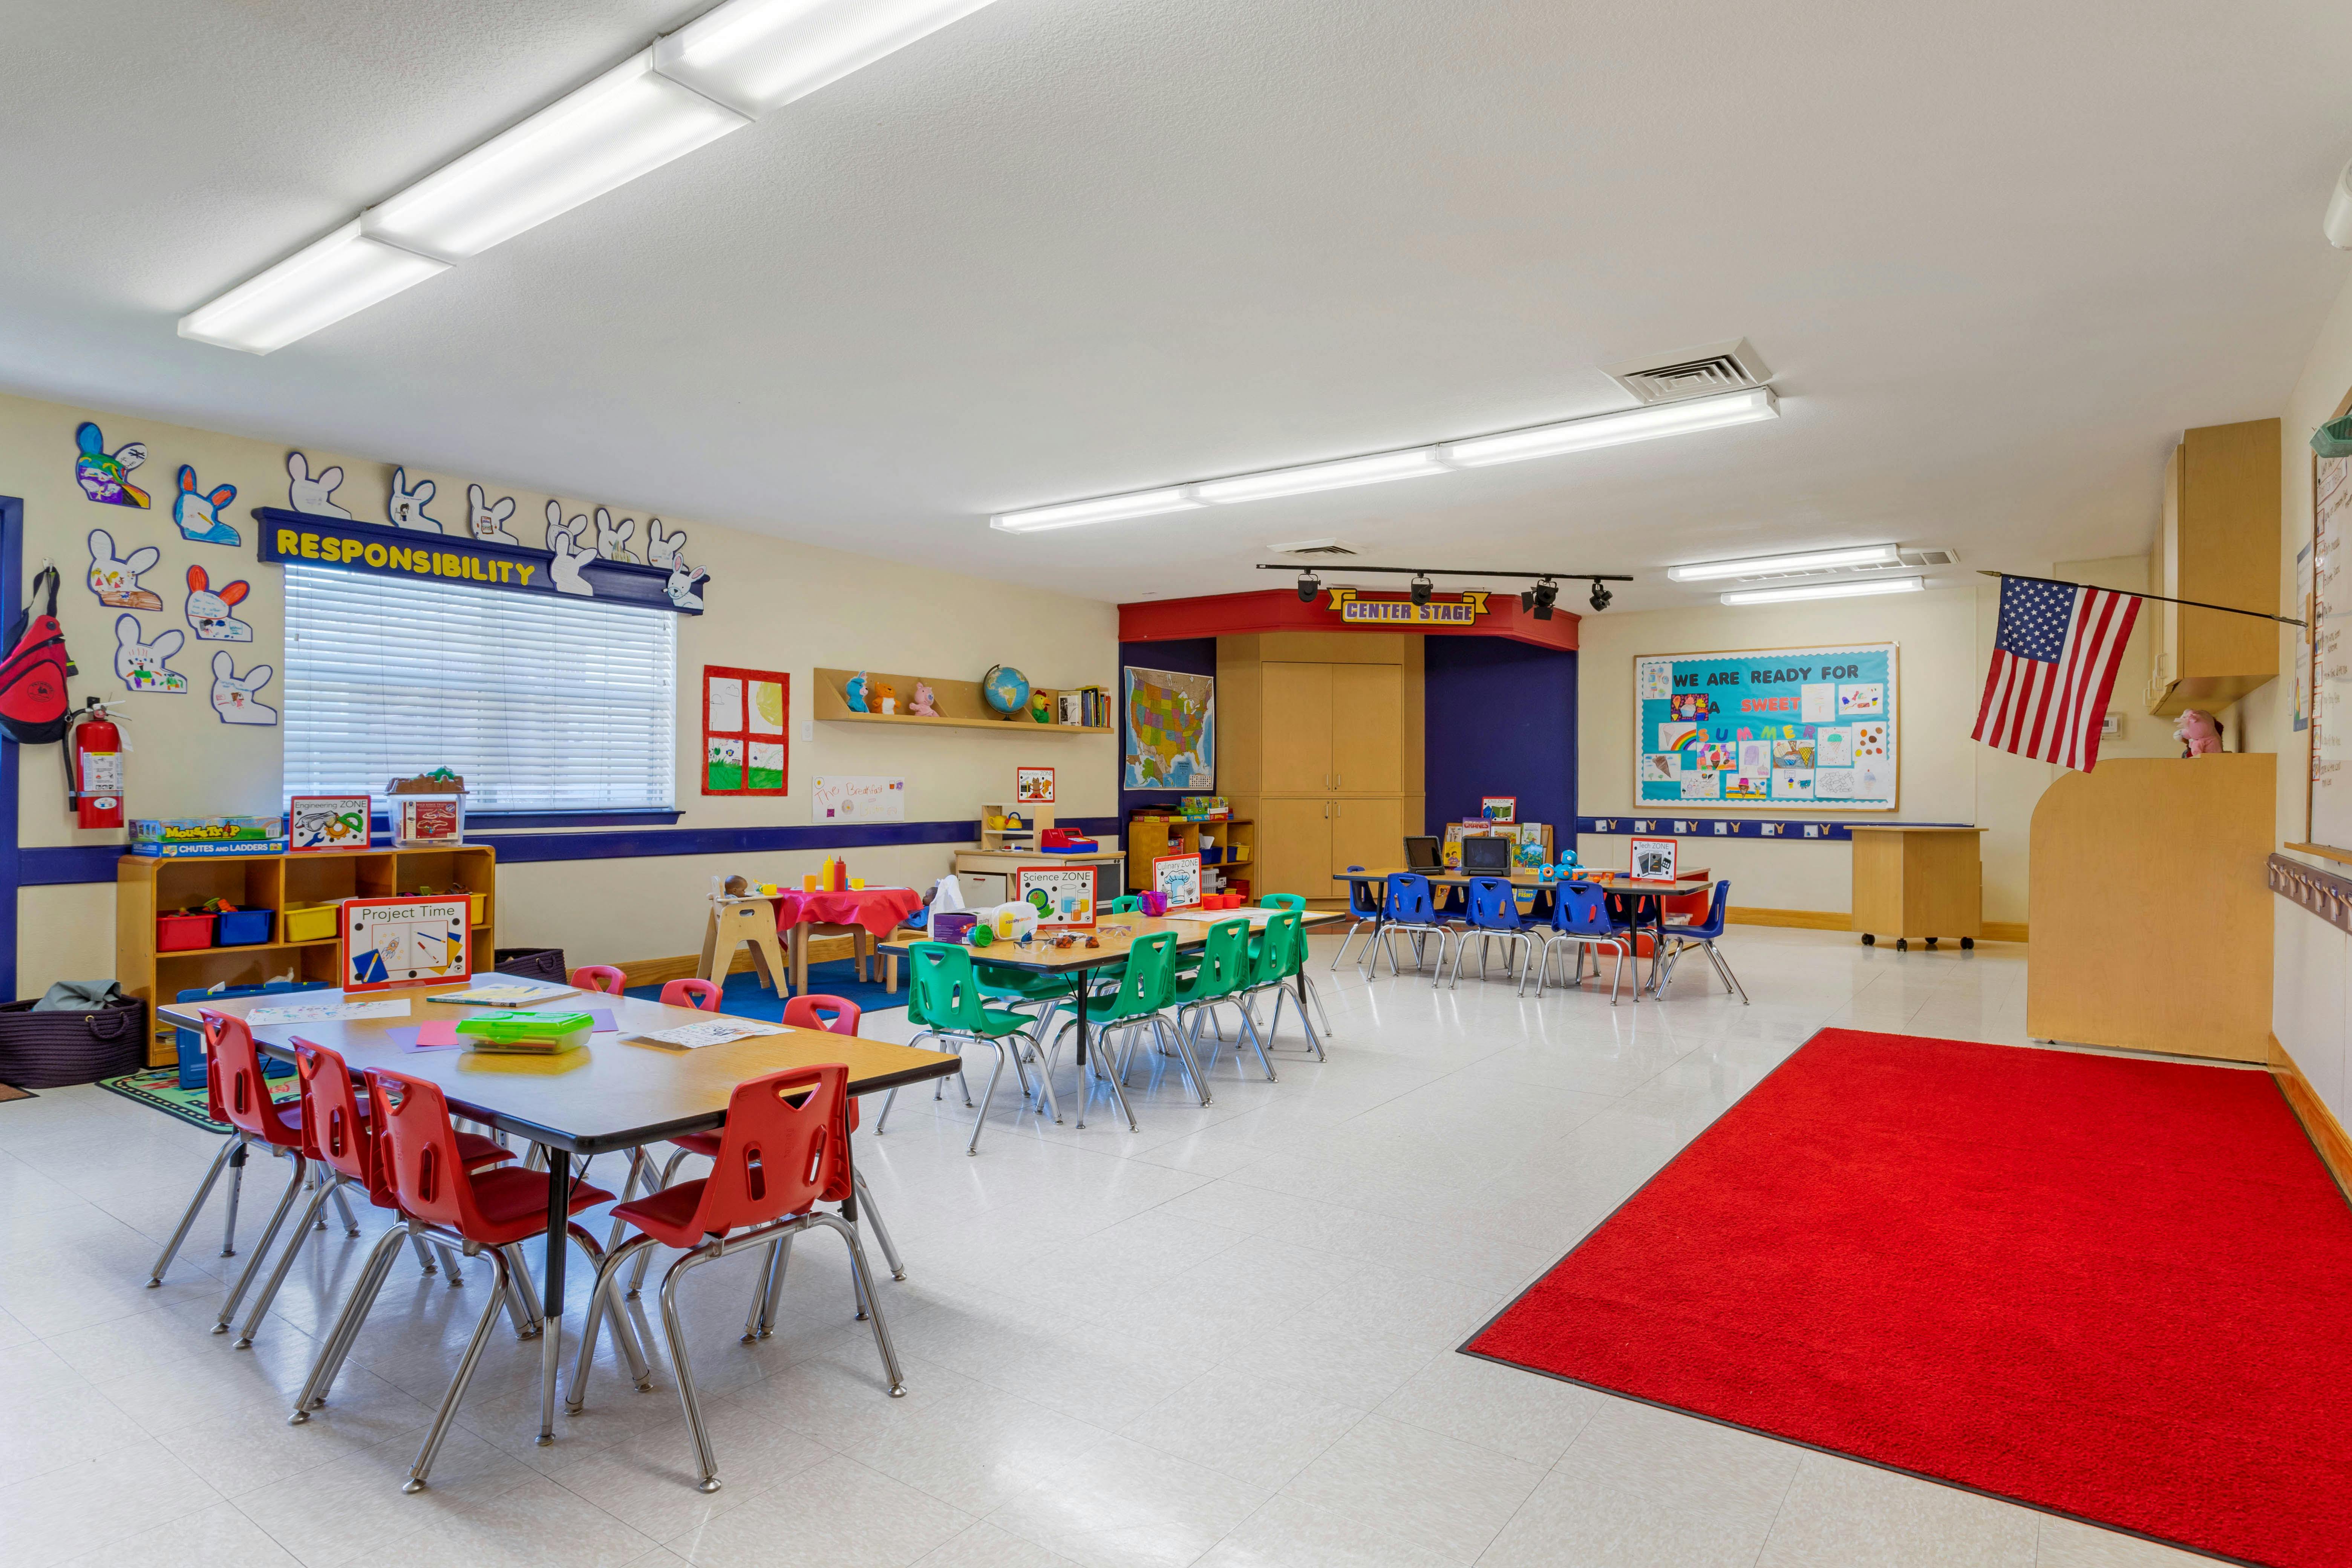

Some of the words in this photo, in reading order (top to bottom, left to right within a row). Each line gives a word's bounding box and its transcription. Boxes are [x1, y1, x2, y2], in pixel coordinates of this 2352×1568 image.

[277, 529, 534, 586] RESPONSIBILITY
[1345, 603, 1411, 619] CENTER
[1418, 605, 1472, 622] STAGE
[1674, 674, 1698, 687] WE
[1707, 672, 1740, 686] ARE
[1751, 667, 1811, 684] READY
[1821, 665, 1859, 680] FOR
[1709, 701, 1720, 714] A
[1741, 697, 1801, 712] SWEET
[1698, 724, 1816, 743] SUMMER
[814, 786, 839, 805] The
[846, 782, 883, 796] Breakfast
[1181, 859, 1198, 868] ZONE
[1023, 873, 1059, 881] Science
[1062, 872, 1091, 880] ZONE
[362, 908, 415, 922] Project
[419, 905, 455, 917] Time
